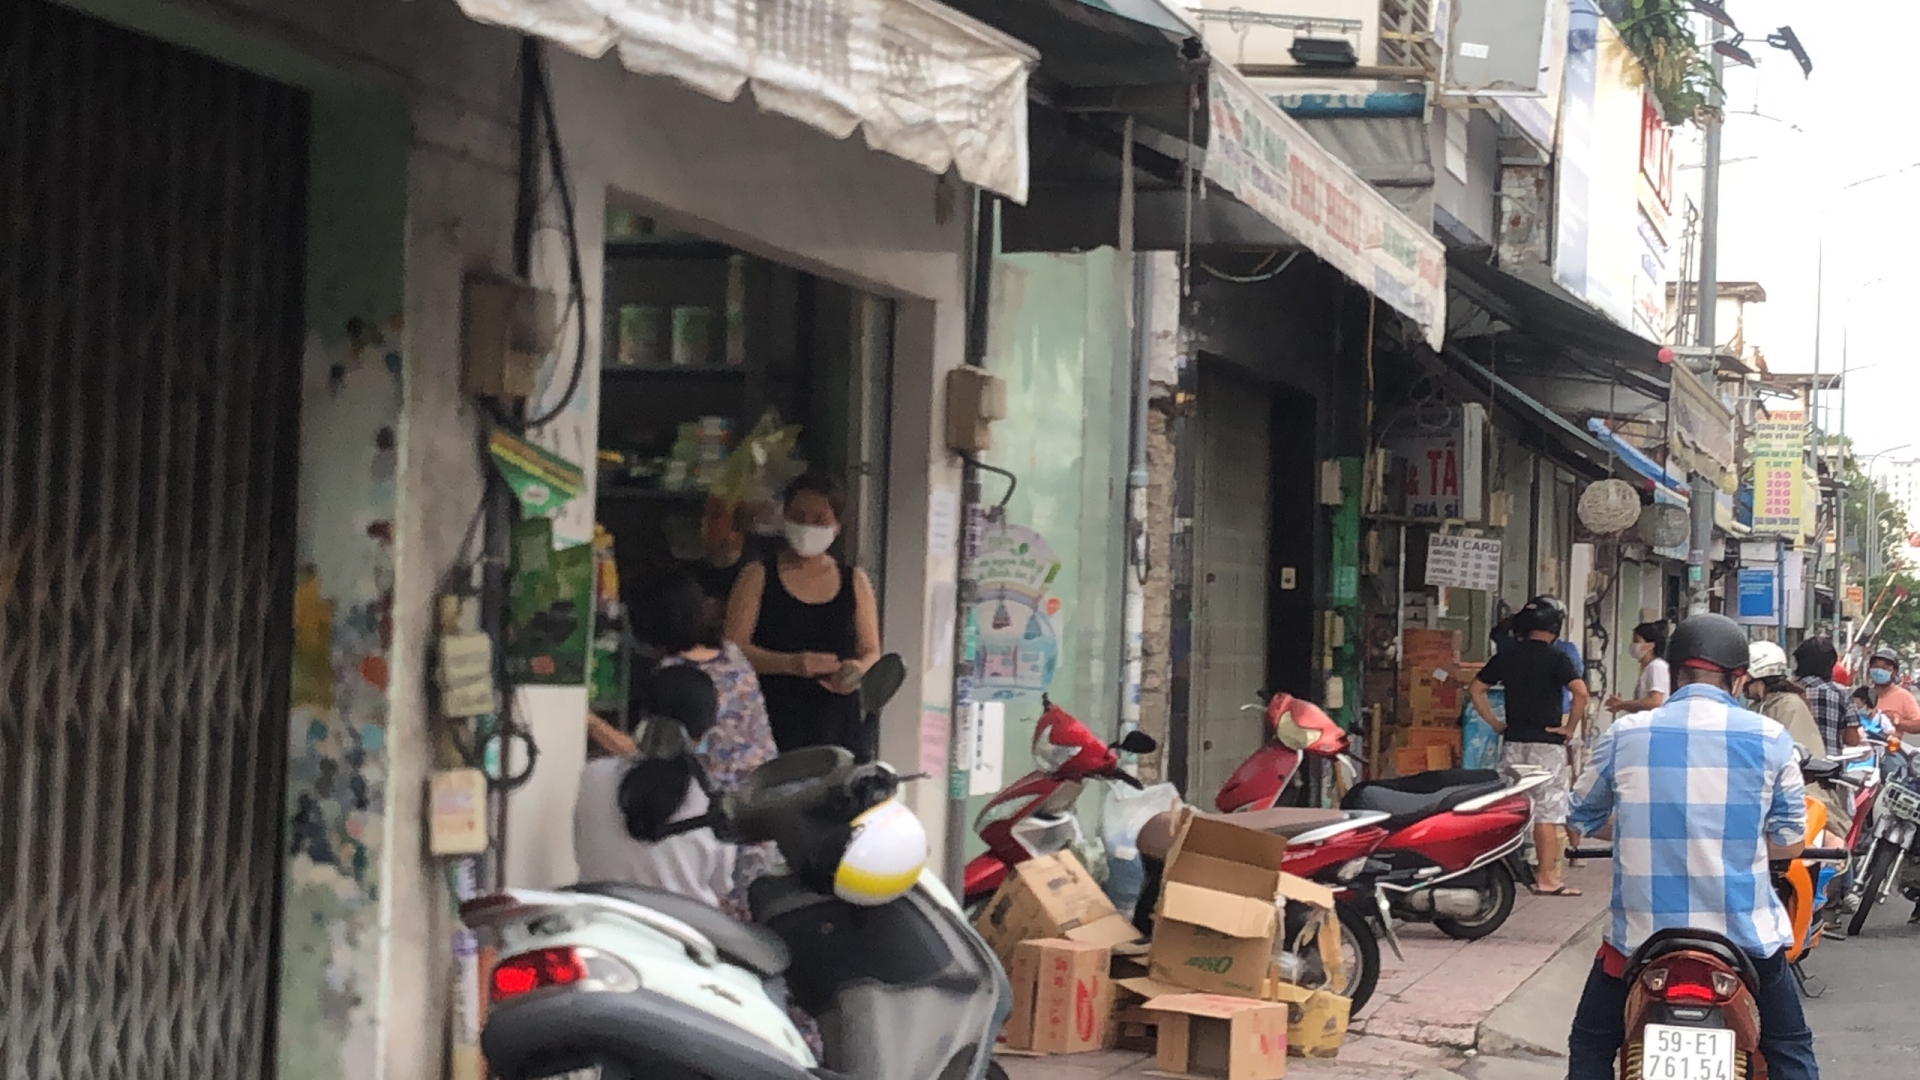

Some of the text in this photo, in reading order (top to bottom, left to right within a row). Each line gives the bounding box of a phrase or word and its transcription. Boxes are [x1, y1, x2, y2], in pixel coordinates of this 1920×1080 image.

[1427, 441, 1458, 496] TÃ
[1462, 540, 1500, 554] CARD
[1658, 1030, 1717, 1056] 59-E1
[1649, 1055, 1726, 1080] 761.54
